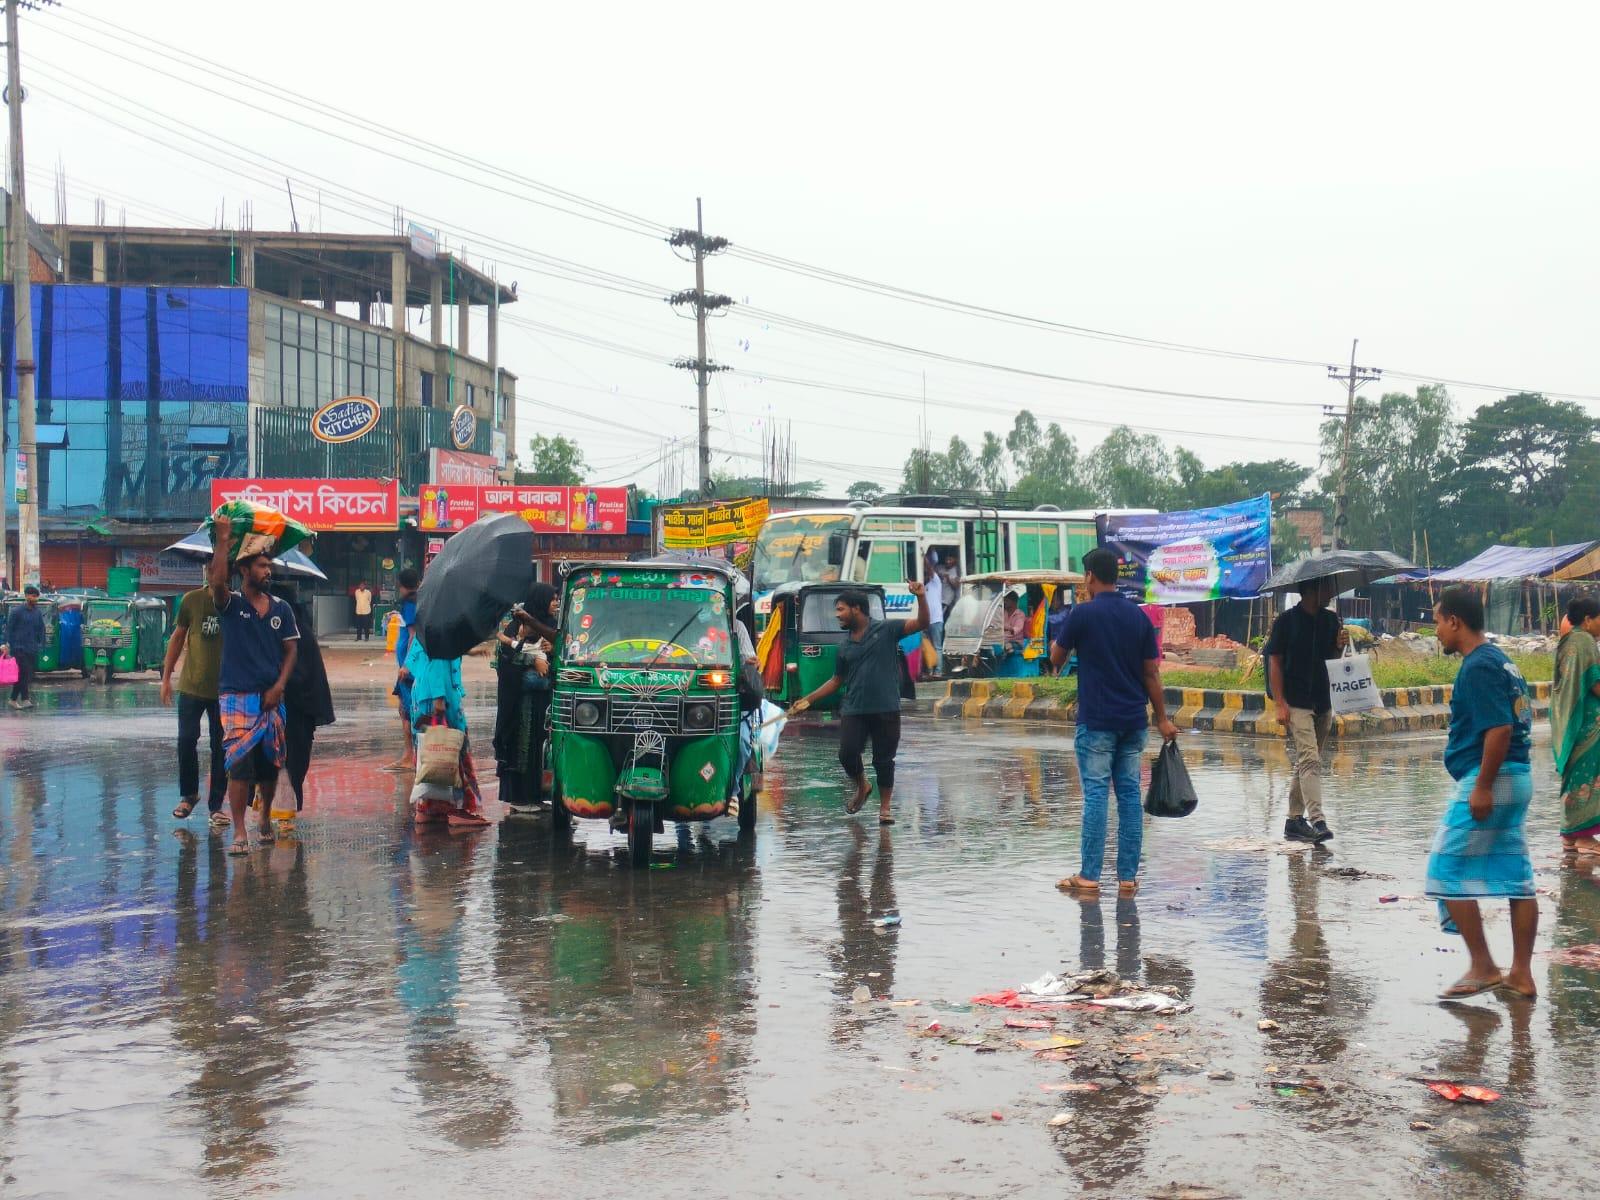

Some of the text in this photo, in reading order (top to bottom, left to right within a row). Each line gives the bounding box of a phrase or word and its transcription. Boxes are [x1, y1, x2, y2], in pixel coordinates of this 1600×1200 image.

[323, 410, 372, 436] KITCHEN
[317, 485, 389, 515] কিচেন
[484, 490, 514, 505] আল
[201, 621, 220, 635] END
[1331, 677, 1372, 693] TARGET
